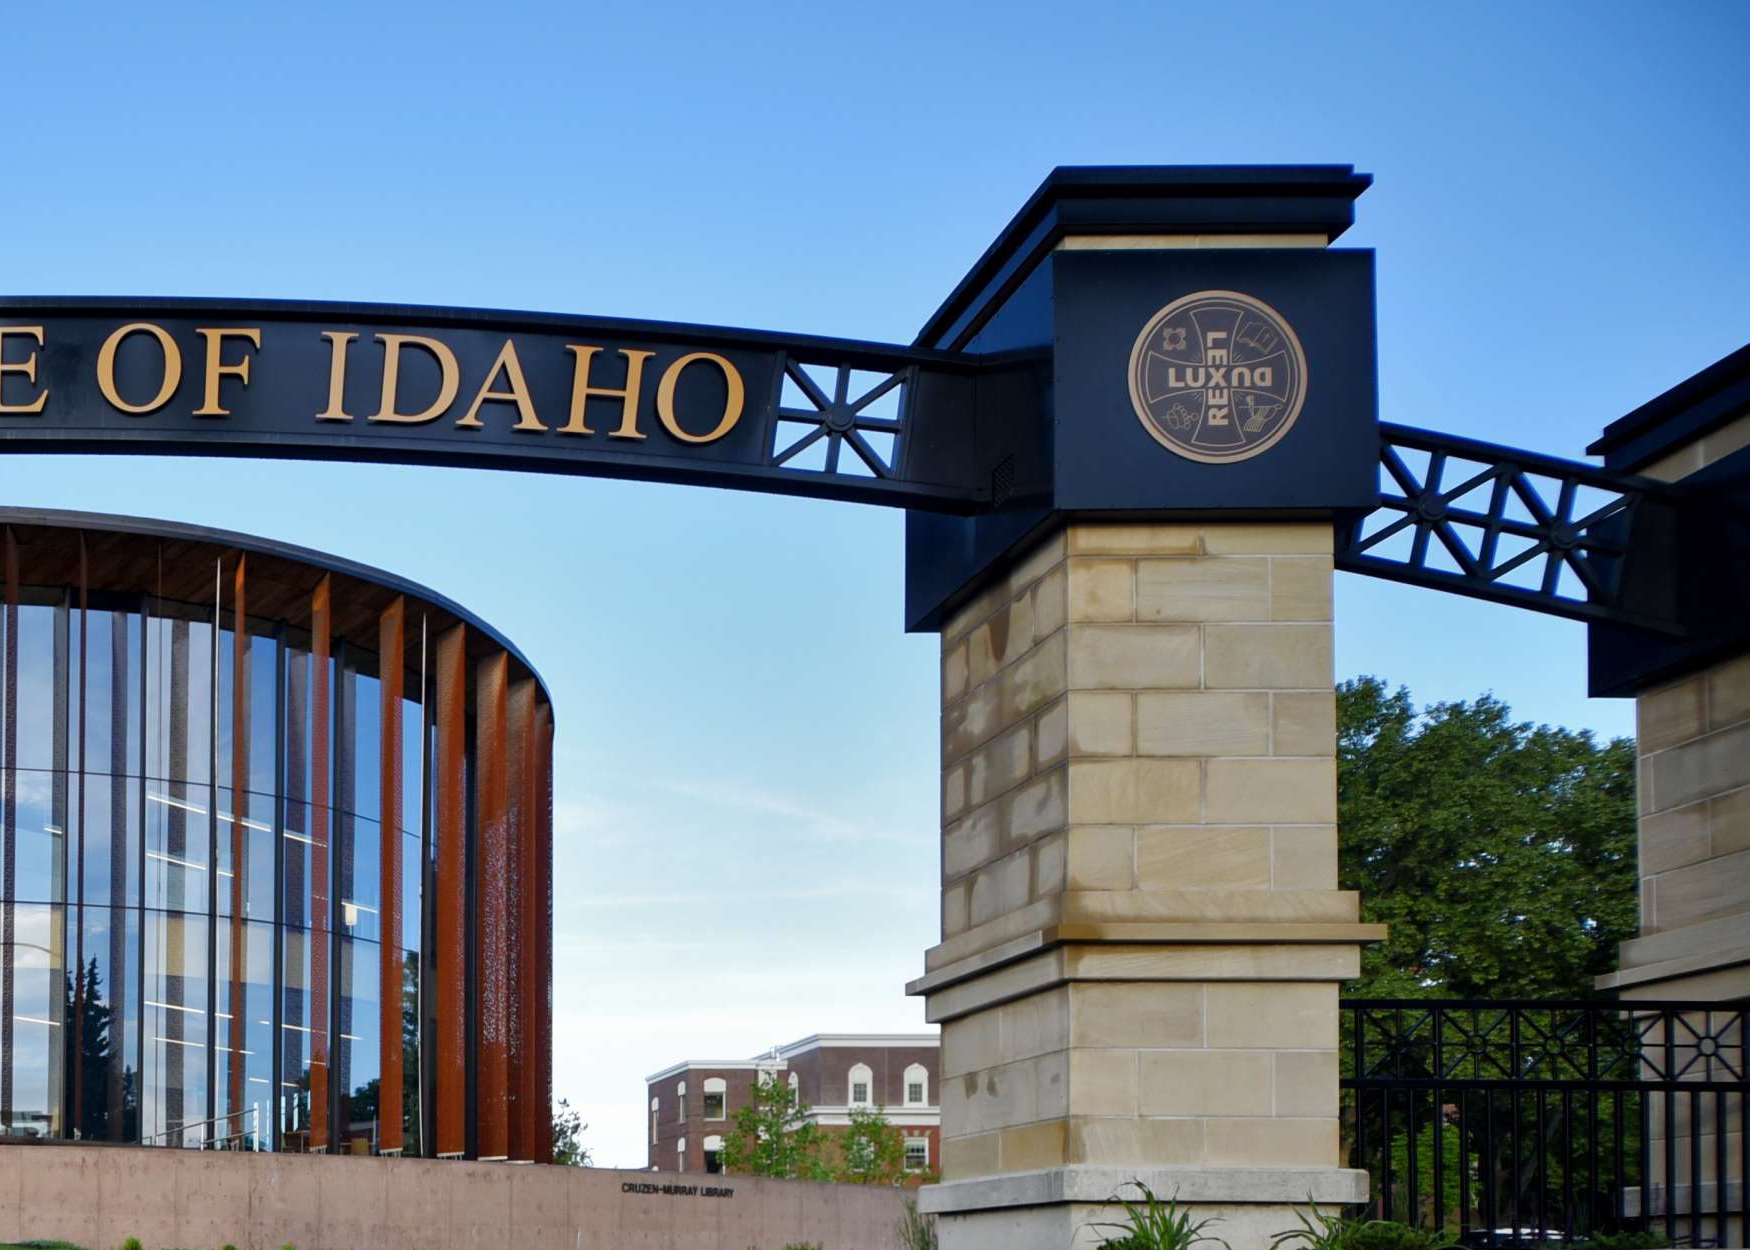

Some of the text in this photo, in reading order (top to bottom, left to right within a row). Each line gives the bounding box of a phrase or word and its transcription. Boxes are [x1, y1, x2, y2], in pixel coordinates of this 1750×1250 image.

[96, 321, 262, 417] OF
[315, 331, 746, 444] IDAHO
[621, 1182, 734, 1199] CRUZEN-MURRAY LIBRARY
